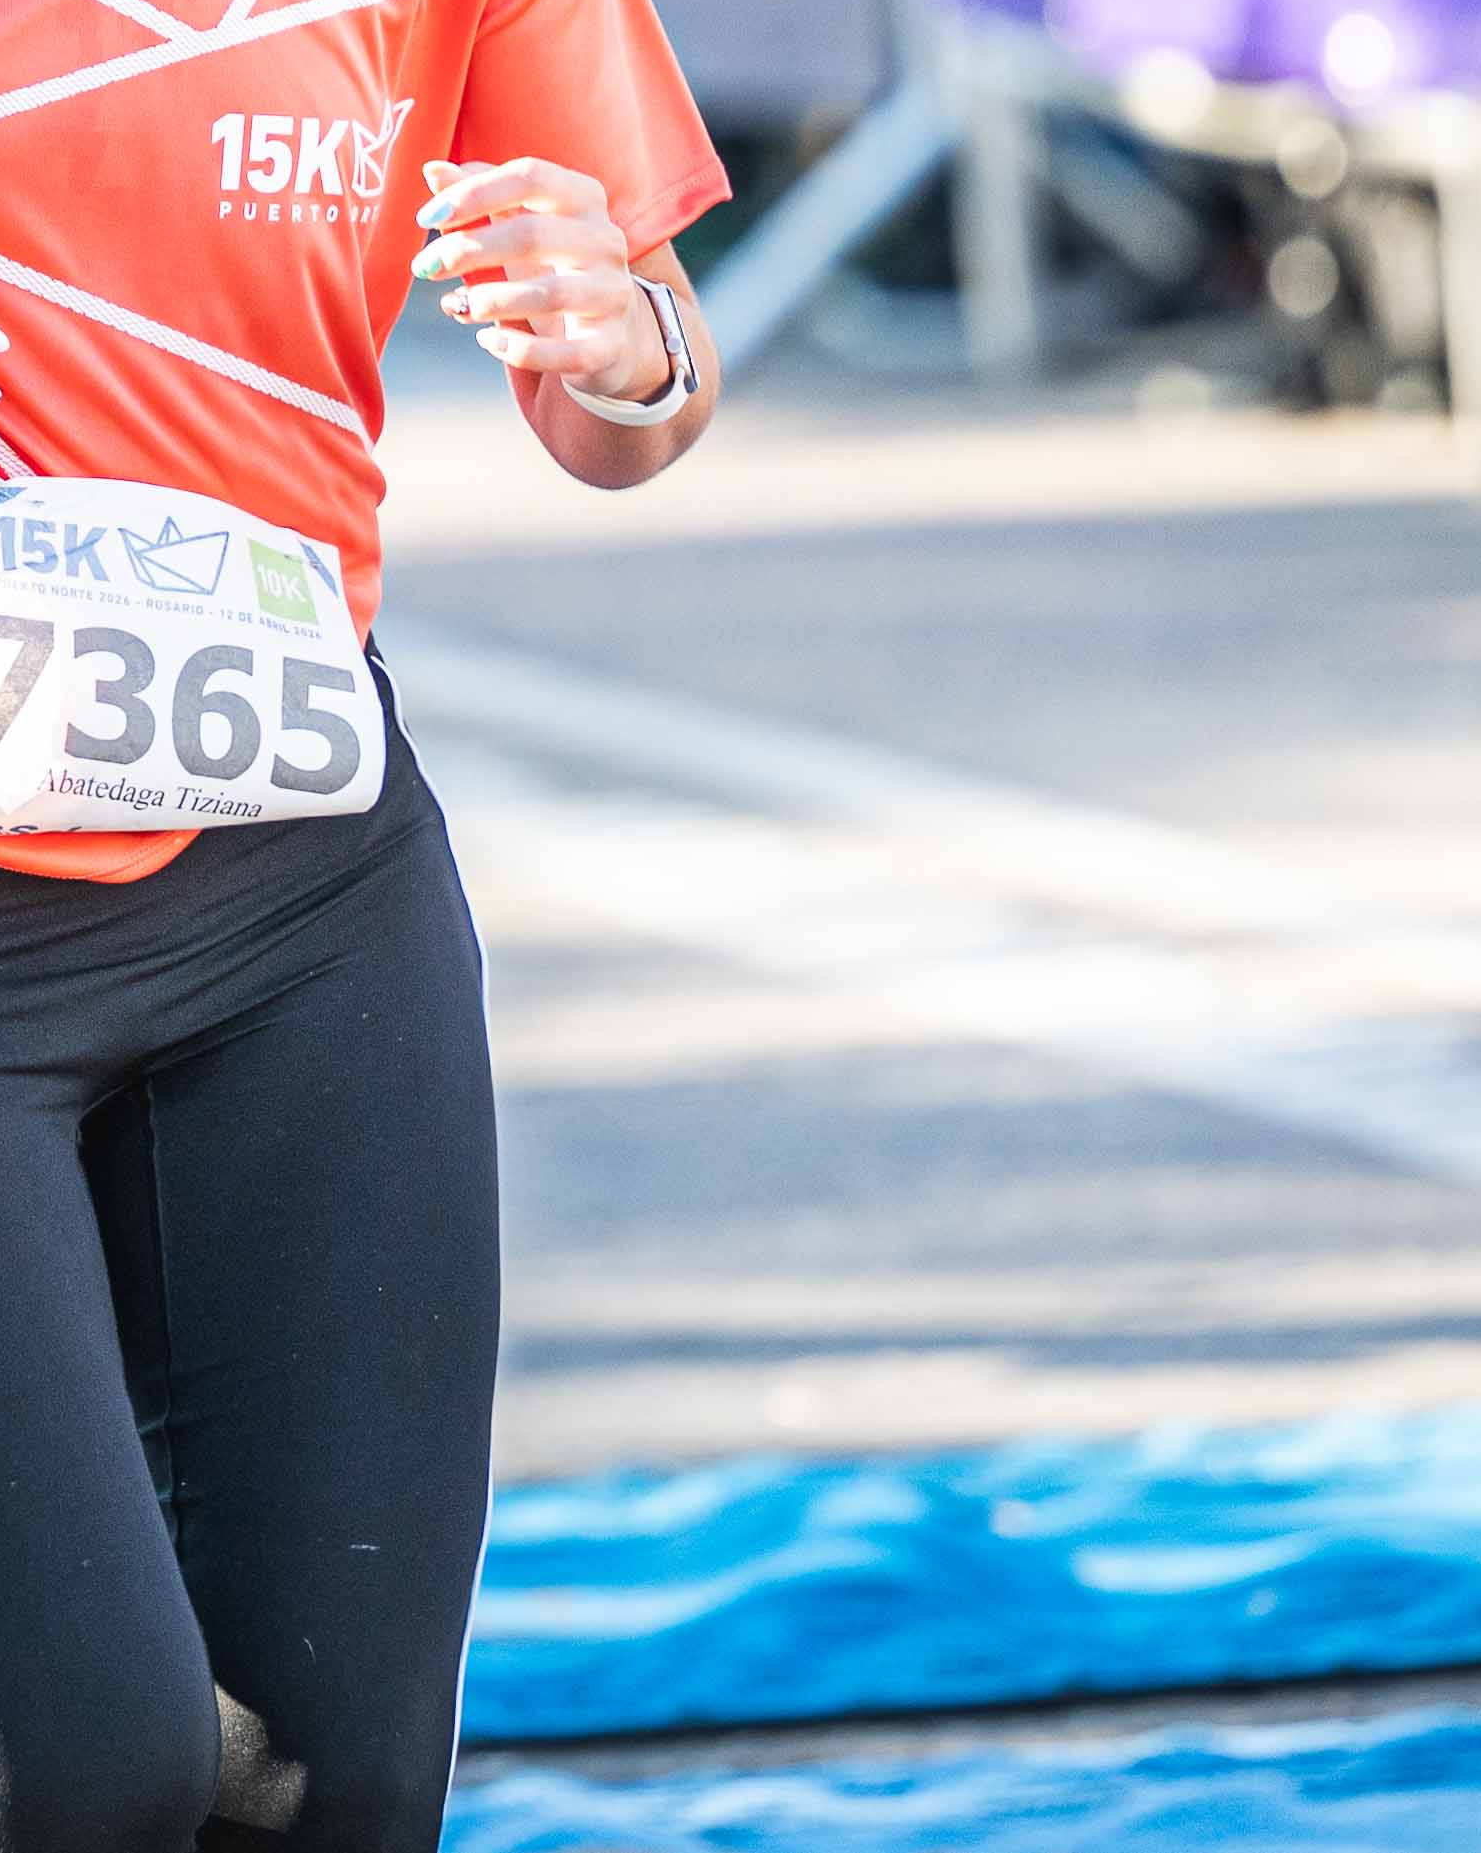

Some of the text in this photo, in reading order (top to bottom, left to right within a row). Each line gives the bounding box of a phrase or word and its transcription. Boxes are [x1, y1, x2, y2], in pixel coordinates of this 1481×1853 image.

[210, 111, 345, 196] 15K
[218, 201, 340, 224] PUERTO
[51, 584, 93, 601] NORTE
[99, 591, 131, 607] 2026
[145, 598, 204, 616] ROSARIO
[219, 608, 233, 621] 12
[238, 612, 253, 624] DE
[256, 562, 307, 604] 10K
[36, 766, 264, 819] Abatedaga Tiziana
